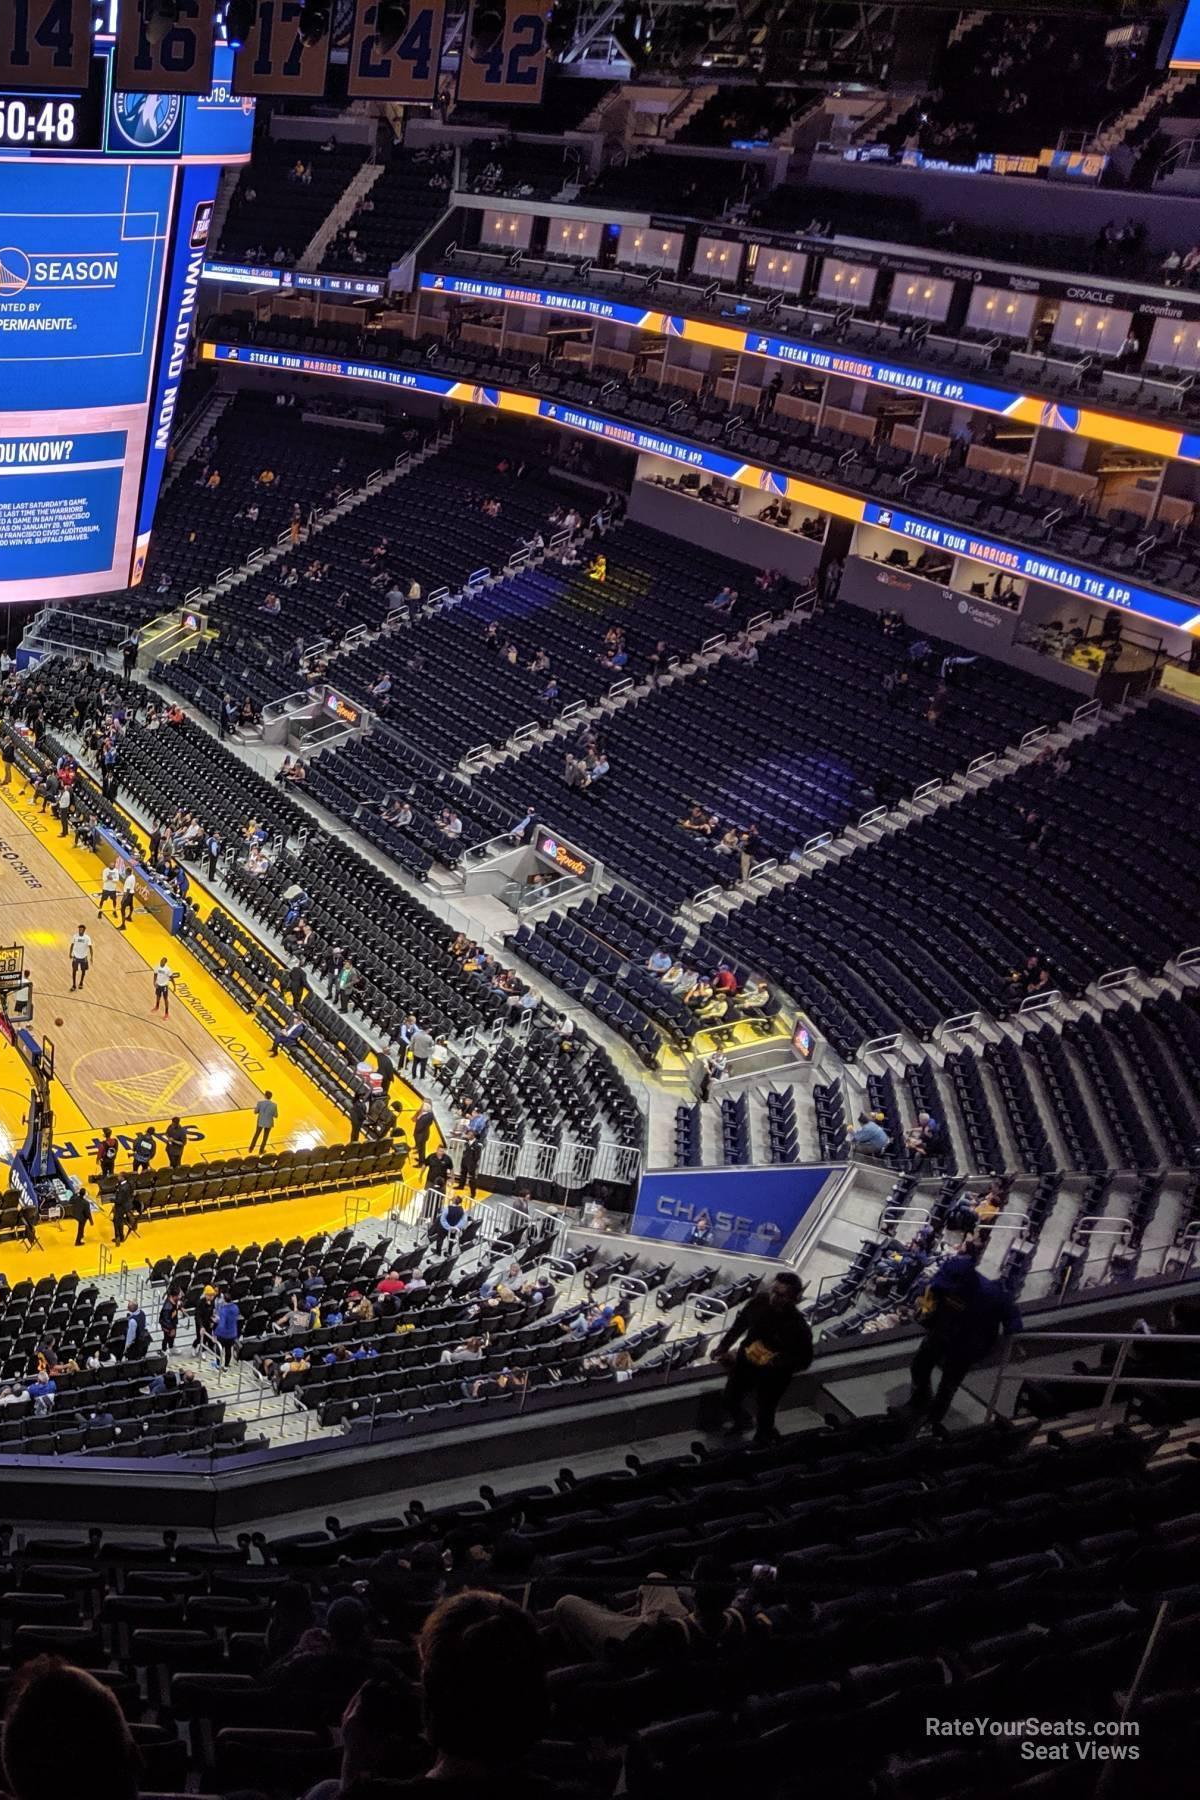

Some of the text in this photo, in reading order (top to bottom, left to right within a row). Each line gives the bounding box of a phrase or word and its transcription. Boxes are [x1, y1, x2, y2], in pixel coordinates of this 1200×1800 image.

[10, 0, 73, 67] 14
[133, 0, 197, 71] 16
[34, 261, 118, 281] SEASON
[211, 265, 233, 273] JACKPOT
[298, 277, 312, 285] NYG
[314, 278, 321, 287] 14
[366, 284, 379, 293] 0:00
[1066, 287, 1114, 304] ORACLE
[29, 303, 41, 312] BY
[454, 281, 481, 295] STREAM
[484, 286, 502, 297] YOUR
[546, 295, 586, 311] DOWNLOAD
[588, 302, 600, 313] THE
[1139, 303, 1183, 318] accenture
[250, 352, 279, 365] STREAM
[281, 357, 300, 368] YOUR
[347, 366, 387, 380] DOWNLOAD
[388, 373, 400, 384] THE
[779, 345, 964, 400] STREAM YOUR WARRIORS. DOWNLOAD THE APP.
[154, 386, 177, 449] NOW
[563, 411, 587, 427] STREAM
[588, 418, 603, 432] YOUR
[638, 434, 673, 454] DOWNLOAD
[675, 446, 687, 460] THE
[18, 440, 74, 462] KNOW?
[29, 500, 68, 509] SATURDAY'S
[49, 506, 83, 514] WARRIORS
[22, 523, 52, 531] JANUARY
[54, 513, 90, 521] FRANCISCO
[4, 530, 42, 539] FRANCISCO
[35, 536, 63, 544] BUFFALO
[904, 520, 1131, 607] STREAM YOUR WARRIORS. DOWNLOAD THE APP.
[336, 700, 358, 722] Sports
[555, 846, 587, 876] Sports
[10, 860, 43, 890] CENTER
[657, 1195, 753, 1233] CHASE
